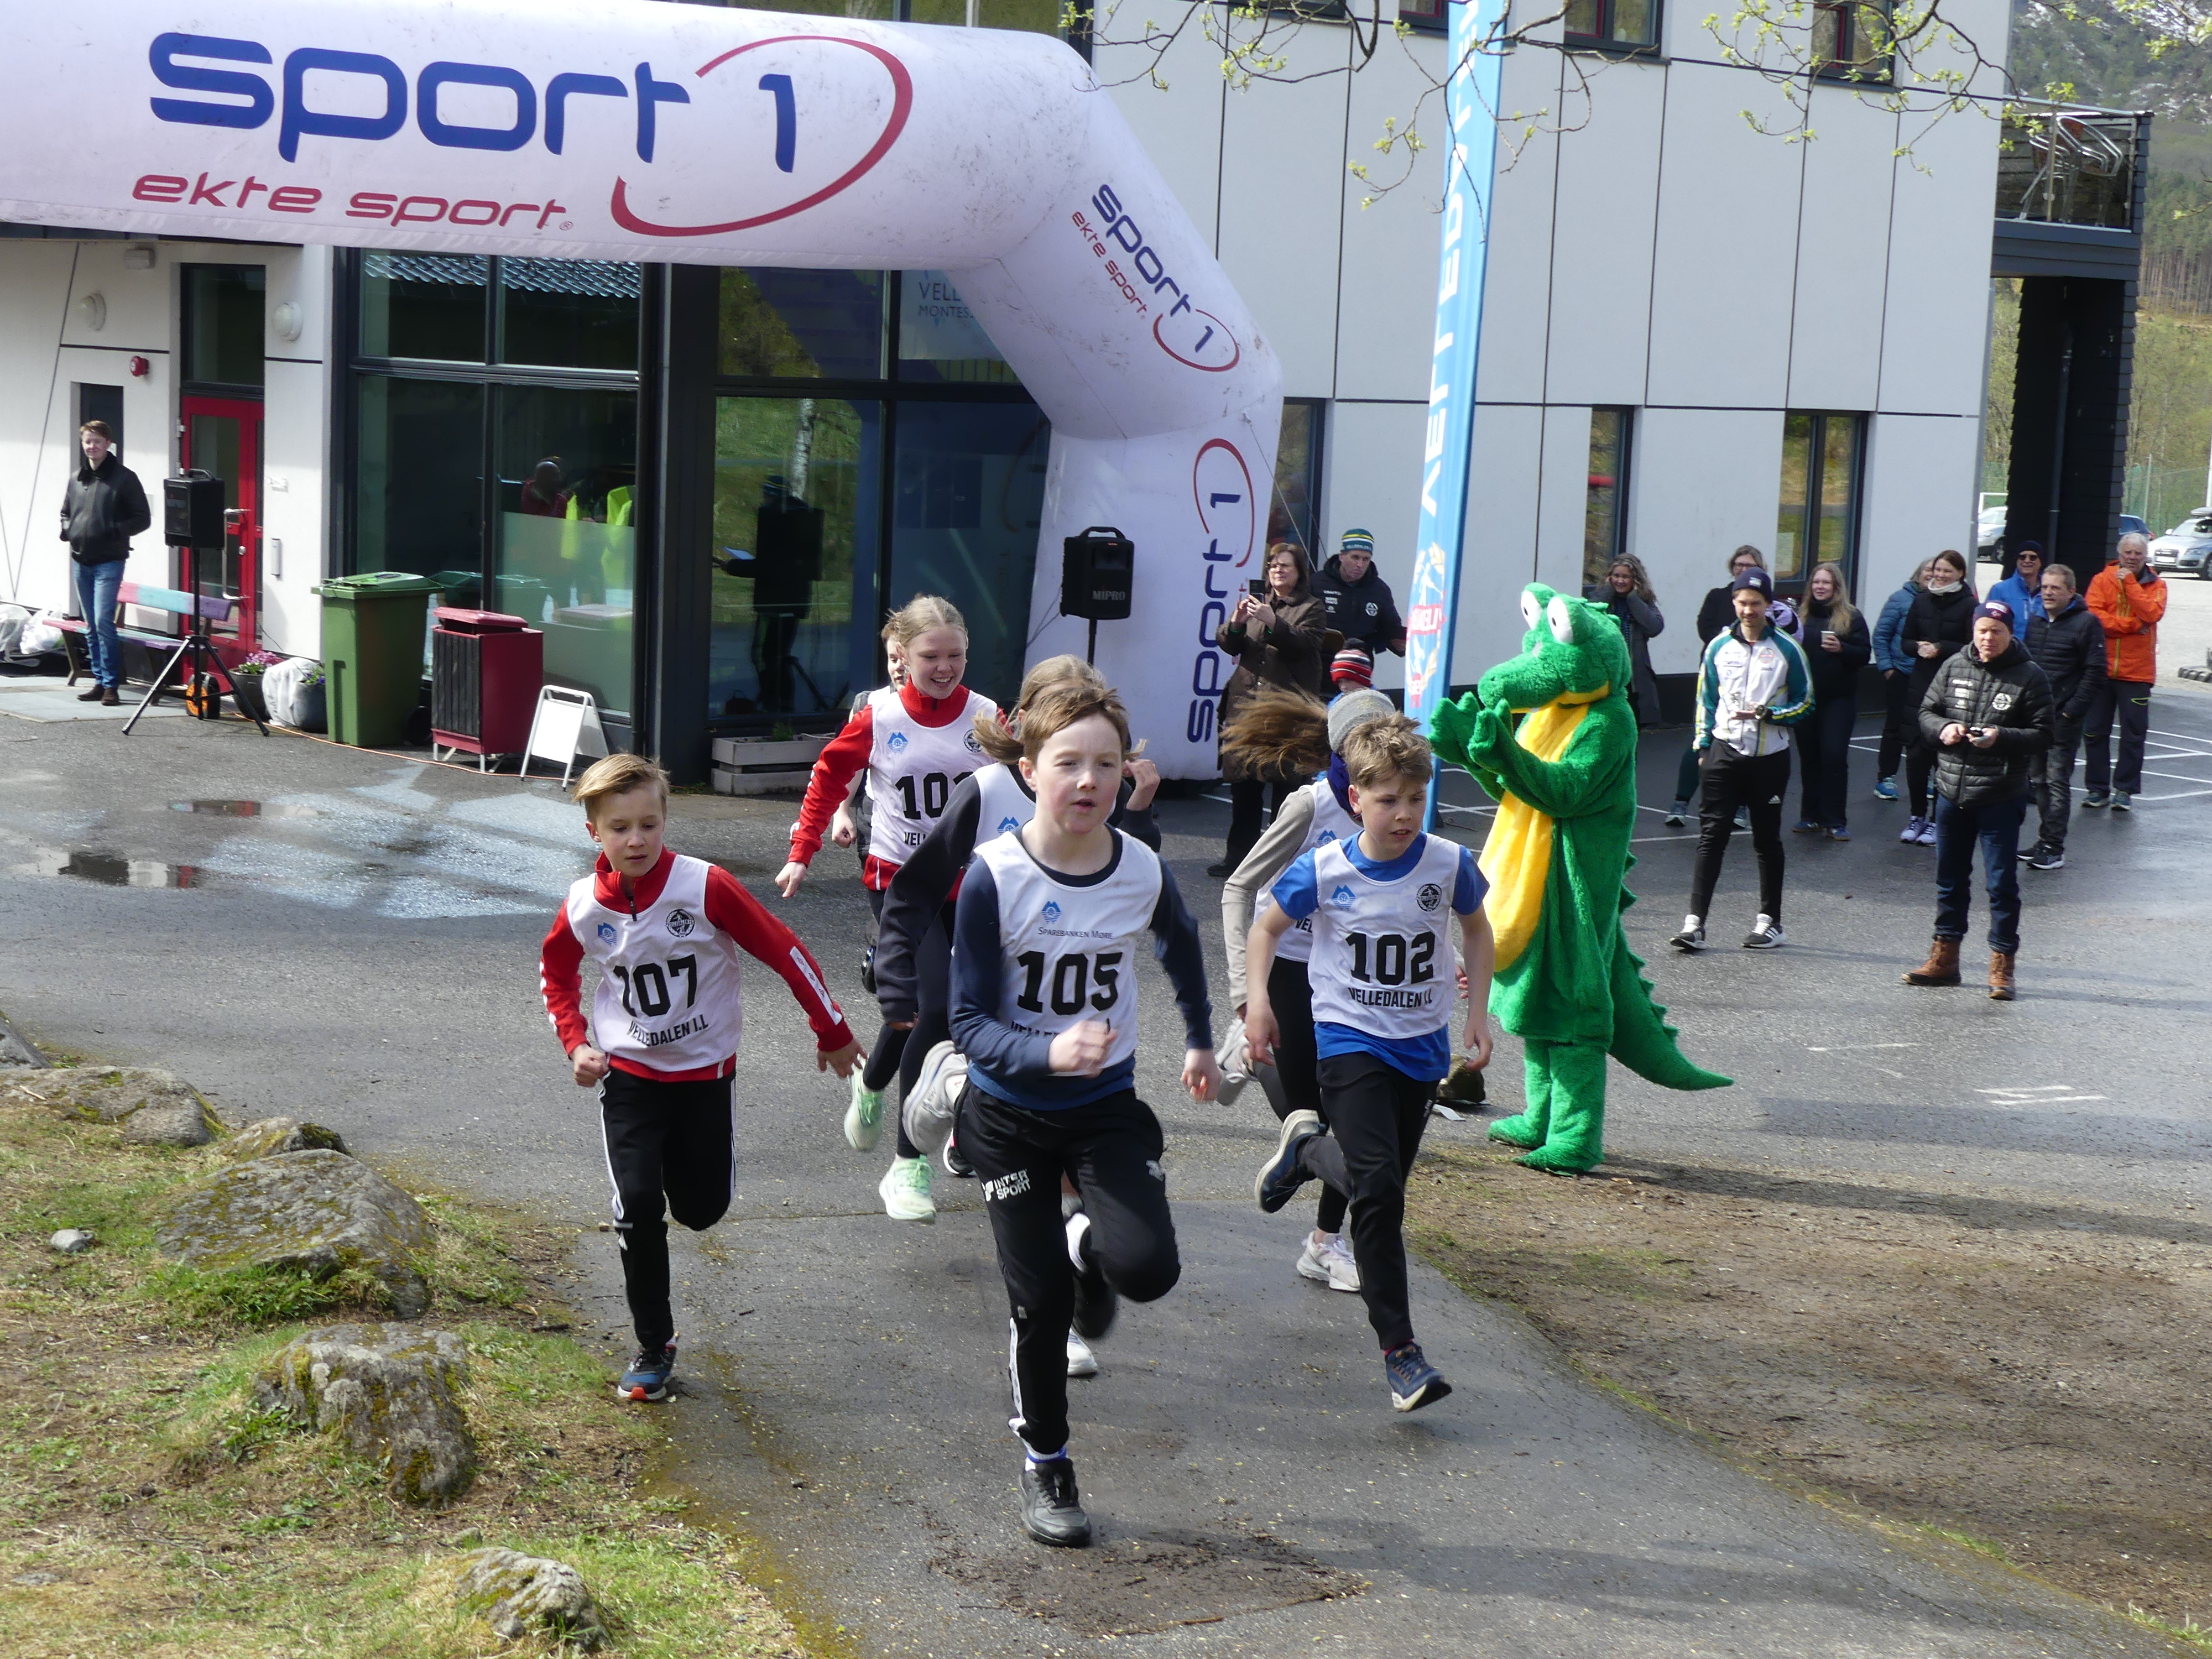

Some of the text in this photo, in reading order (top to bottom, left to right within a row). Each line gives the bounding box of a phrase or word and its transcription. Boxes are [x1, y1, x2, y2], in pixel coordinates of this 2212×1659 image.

[149, 32, 796, 173] sport 1
[132, 172, 566, 229] ekte sport
[1071, 211, 1106, 258] ekte
[1092, 184, 1214, 353] sport 1
[1092, 589, 1126, 601] MIPRO
[1187, 493, 1241, 743] sport 1
[613, 953, 698, 1018] 107
[1016, 950, 1123, 1016] 105
[1345, 931, 1436, 986] 102
[1348, 987, 1422, 1008] VELLEDALEN
[627, 1020, 691, 1047] VELLEDALEN
[993, 1169, 1030, 1190] INTER
[996, 1178, 1031, 1200] SPORT
